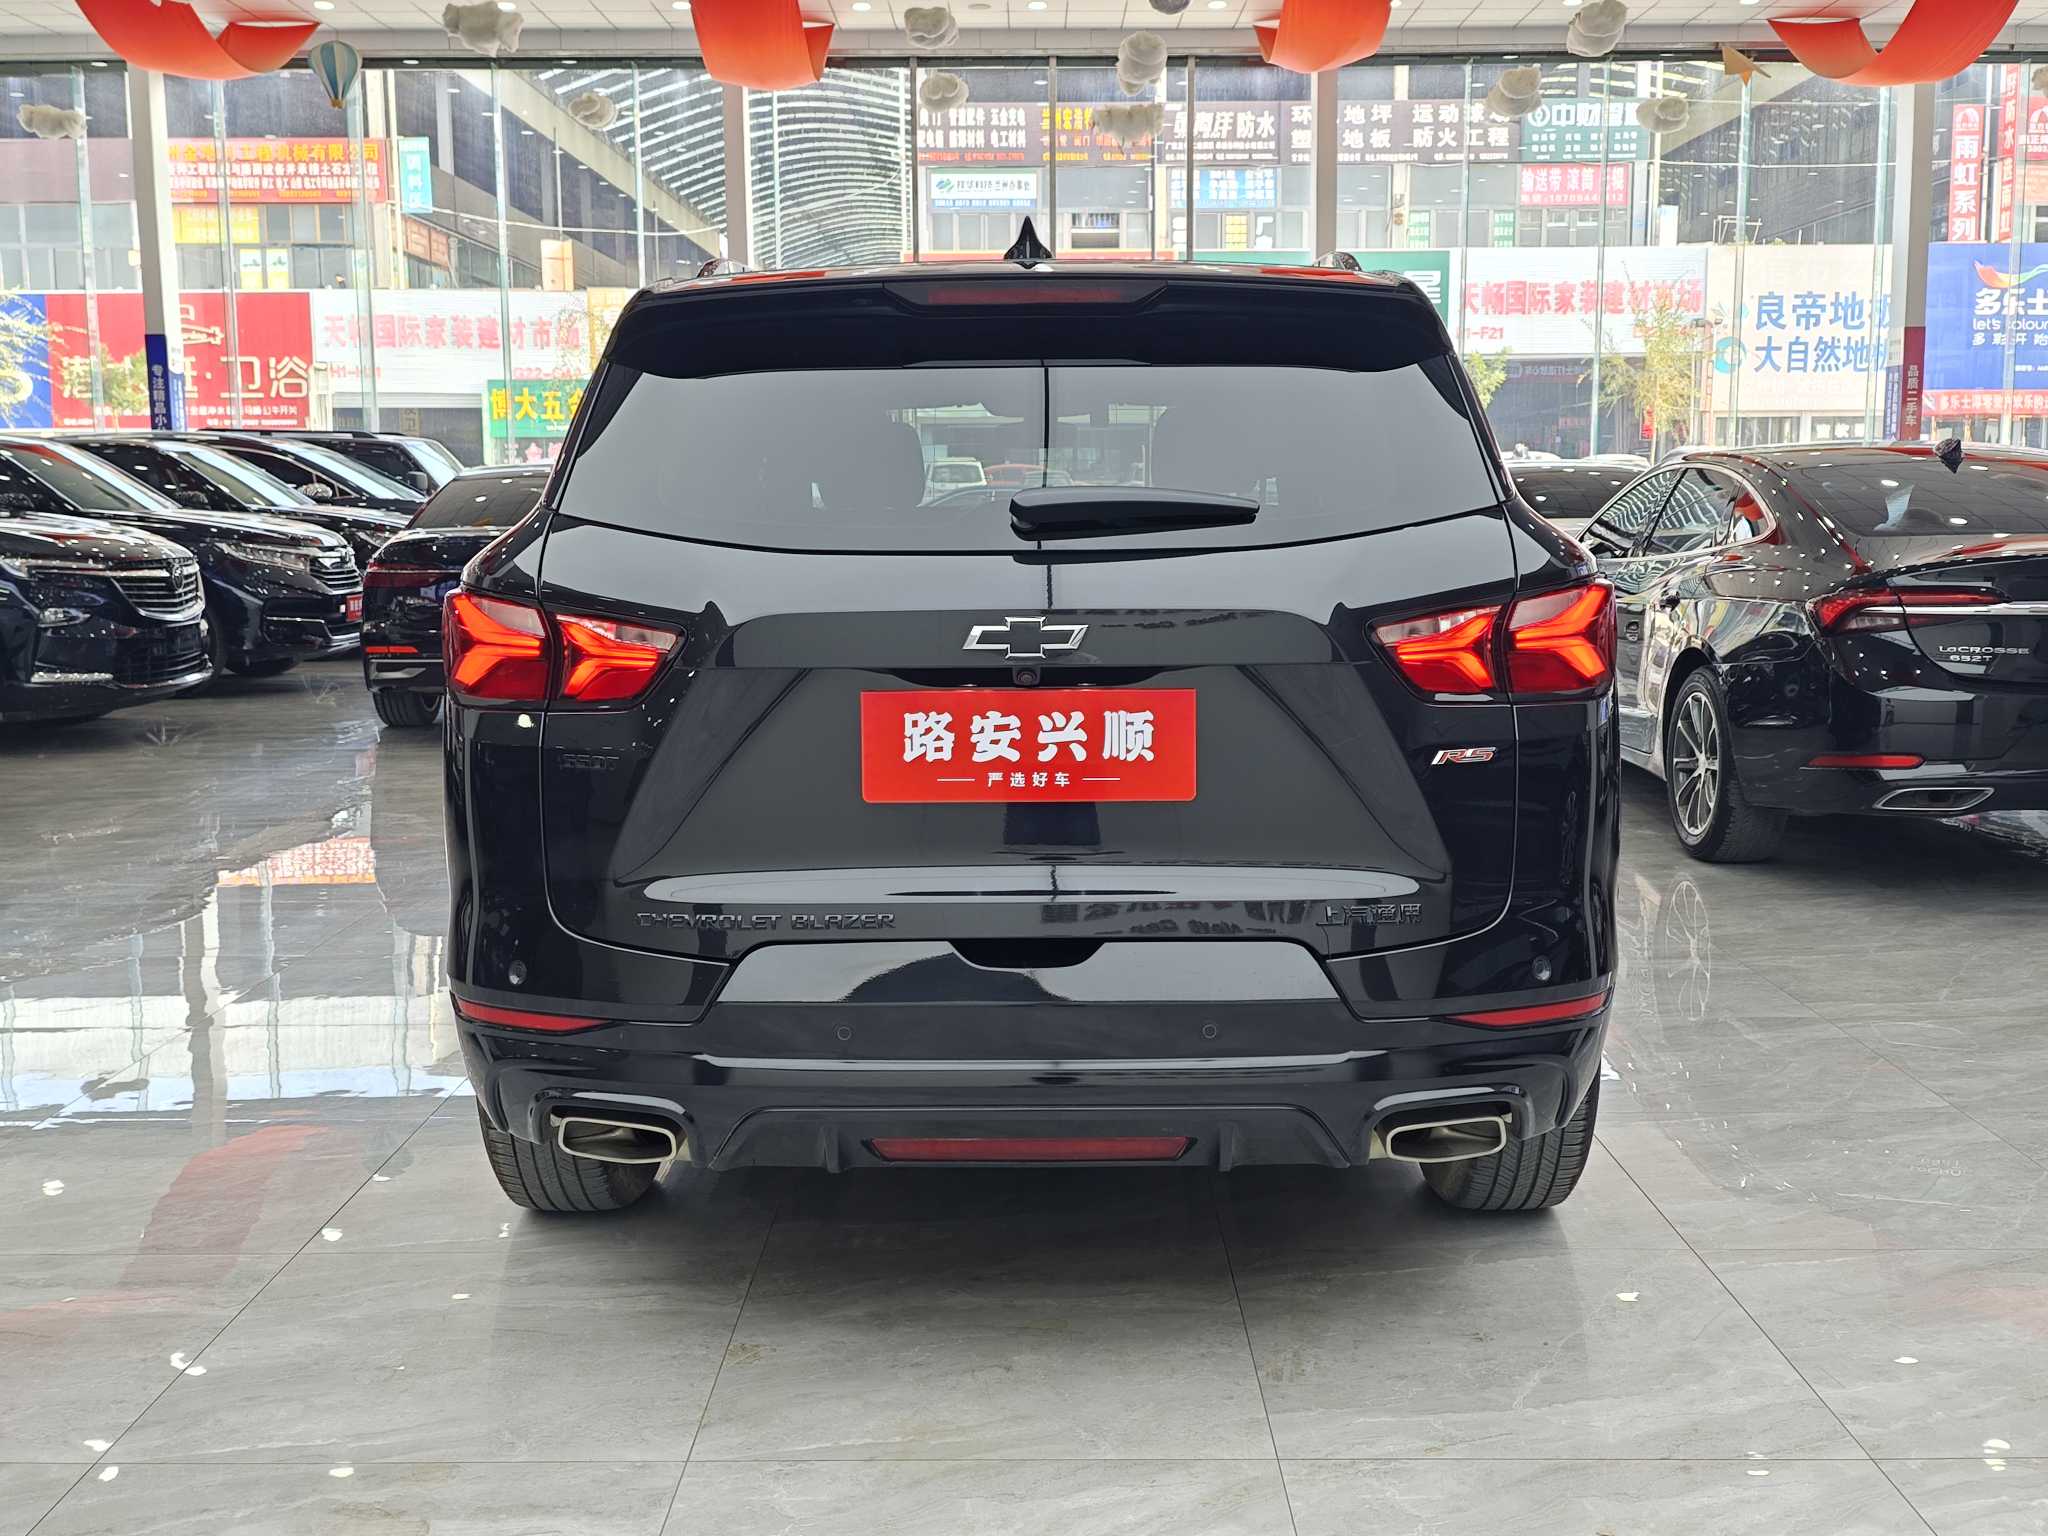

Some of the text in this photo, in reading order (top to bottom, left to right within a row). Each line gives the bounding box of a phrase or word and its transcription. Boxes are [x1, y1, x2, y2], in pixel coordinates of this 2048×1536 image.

[1291, 103, 1393, 124] 环地坪
[1291, 128, 1392, 149] 塑地板
[1412, 127, 1510, 148] 防火工程
[1951, 134, 1980, 241] 雨虹系列
[1973, 287, 2048, 316] 多乐士
[1972, 318, 2048, 330] let's olour
[151, 363, 168, 432] 专注精品小
[902, 710, 1156, 763] 路安兴顺
[1431, 746, 1497, 765] RS
[987, 771, 1071, 788] 严选好车
[636, 912, 897, 930] CHEVROLET BLAZER
[1315, 903, 1422, 926] 上汽通用
